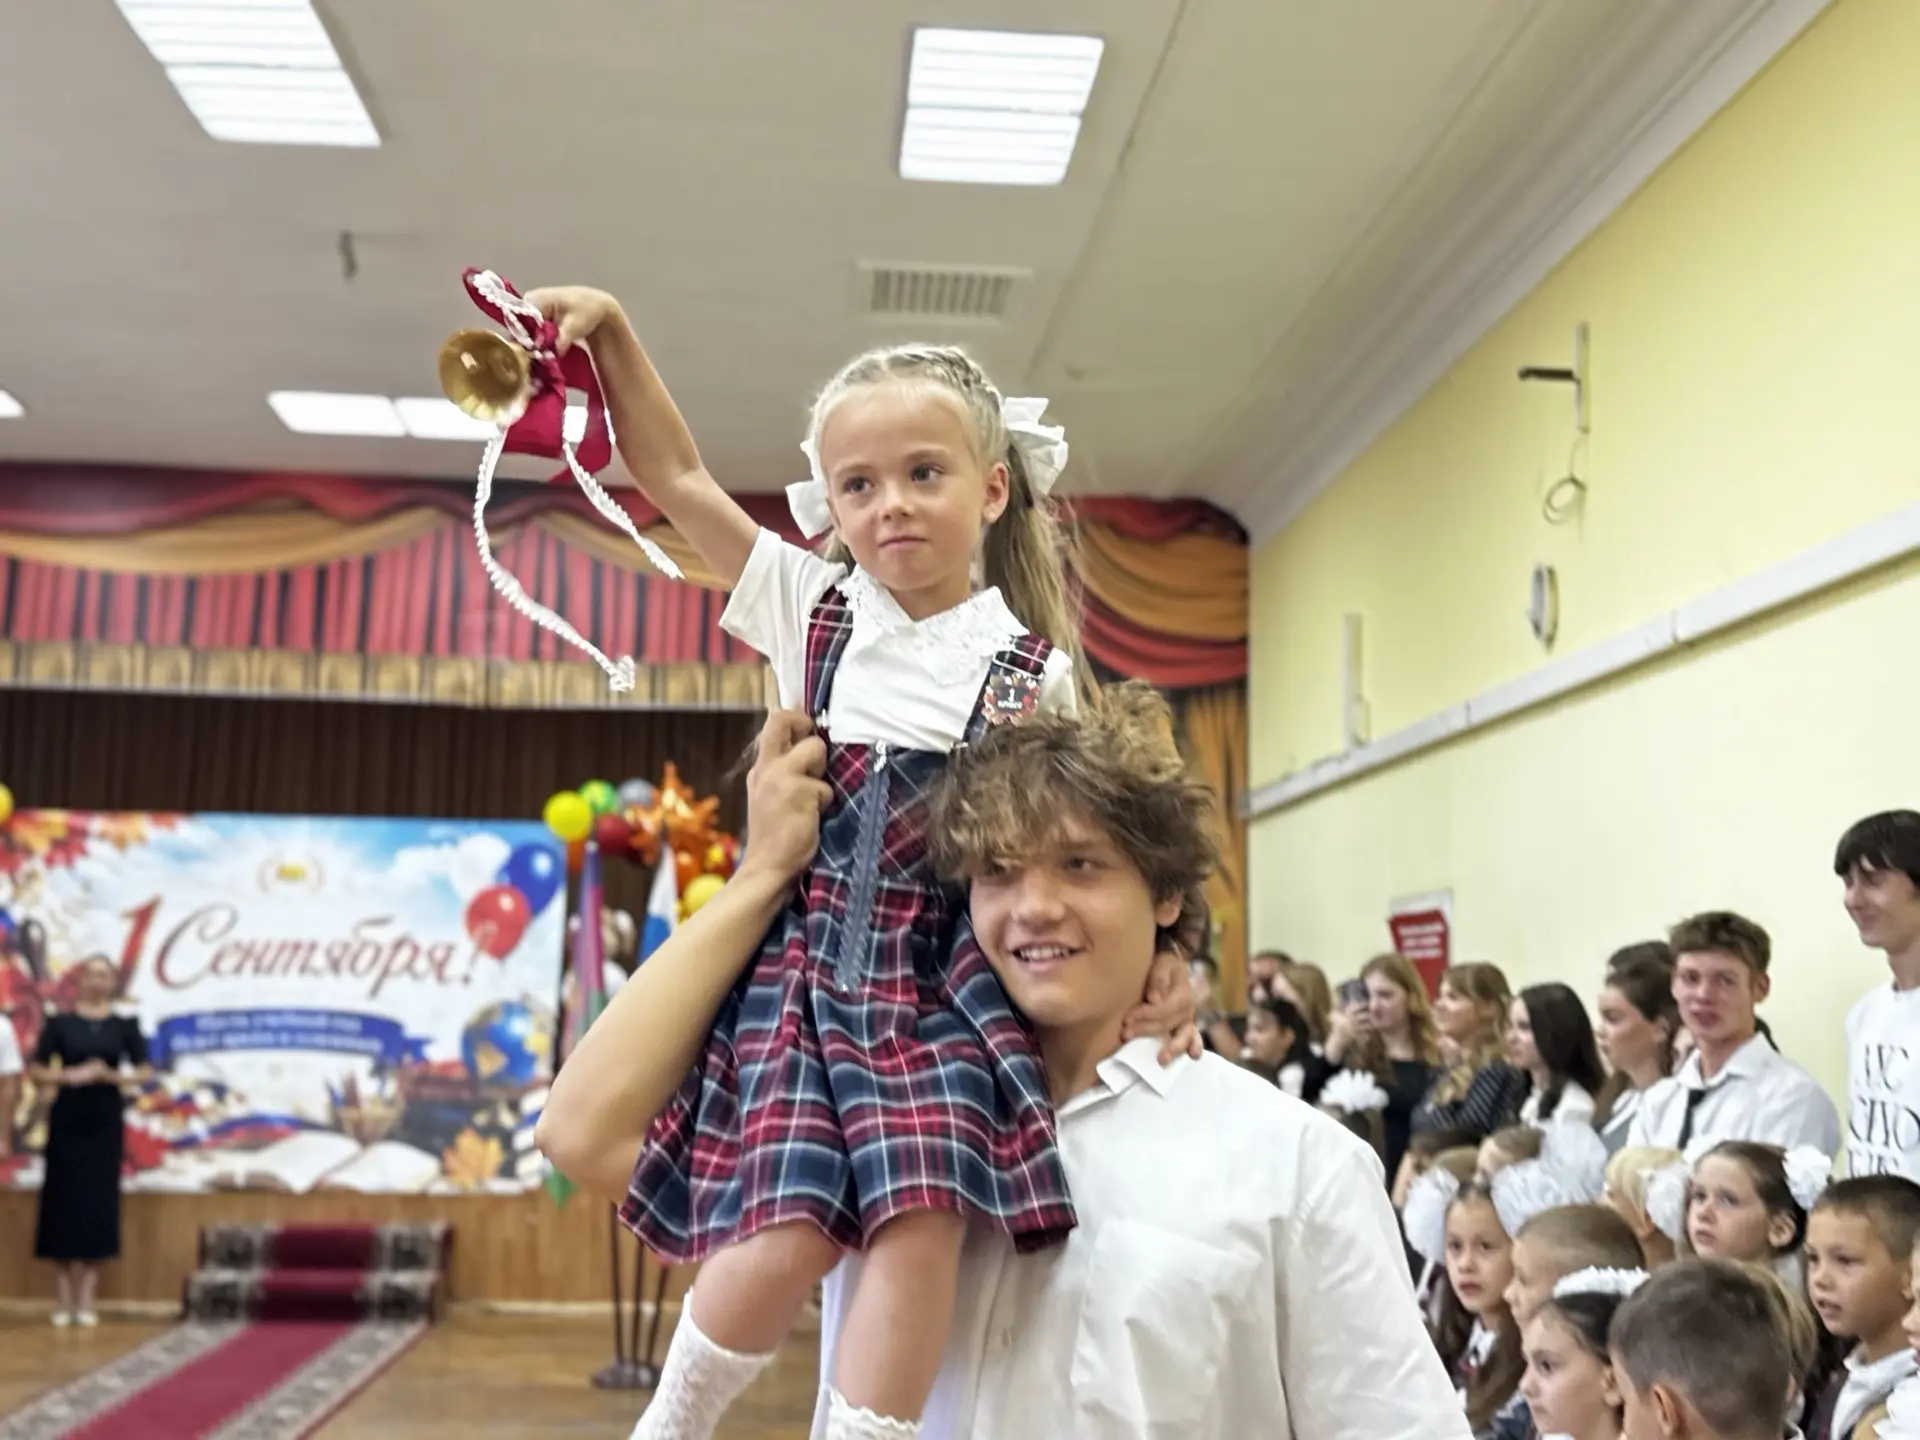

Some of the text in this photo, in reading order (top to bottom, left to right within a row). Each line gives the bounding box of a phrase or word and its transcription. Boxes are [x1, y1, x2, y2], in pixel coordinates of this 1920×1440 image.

[1008, 688, 1015, 702] 1
[112, 894, 499, 1003] 1 Сентября!
